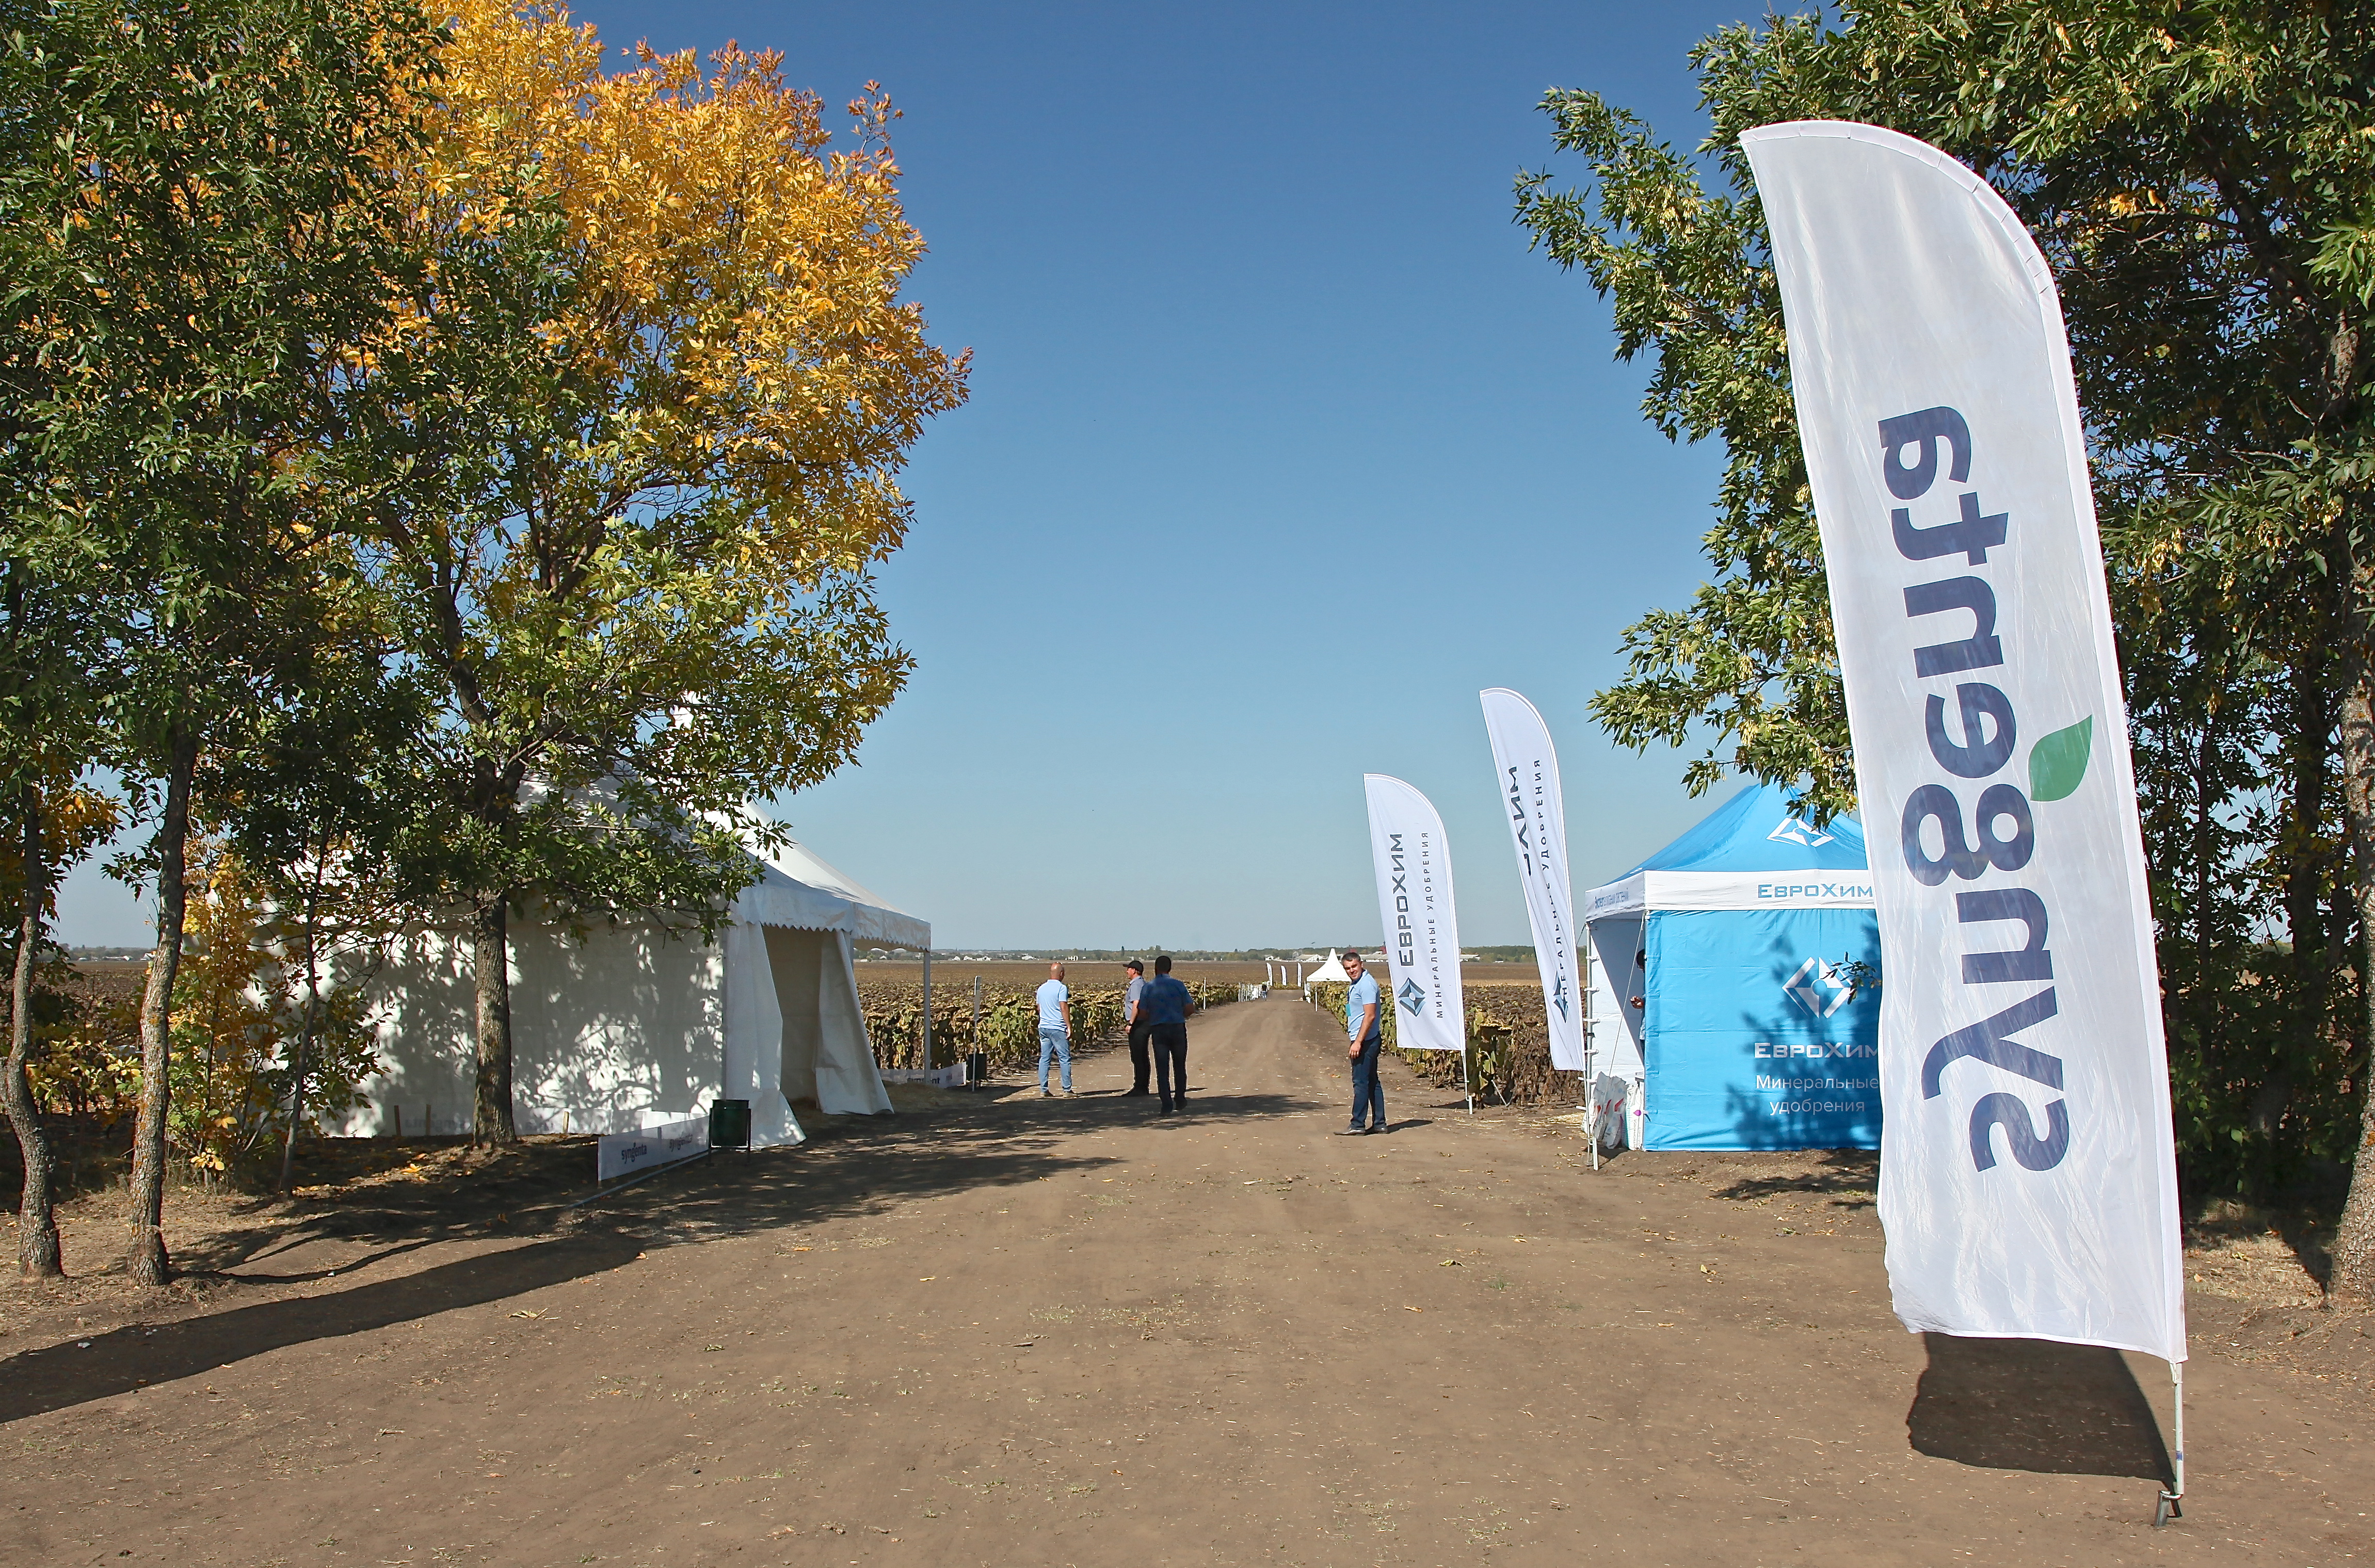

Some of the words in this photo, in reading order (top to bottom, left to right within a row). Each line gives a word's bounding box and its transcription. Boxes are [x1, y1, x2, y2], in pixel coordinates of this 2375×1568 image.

[1533, 759, 1550, 871] УДОБРЕНИЯ
[1421, 832, 1434, 911] УДОБРЕНИЯ
[1427, 918, 1443, 1019] МИНЕРАЛЬНЫЕ
[1756, 1075, 1879, 1090] Минеральные
[1770, 1099, 1865, 1116] удобрения
[621, 1142, 647, 1164] syngenta
